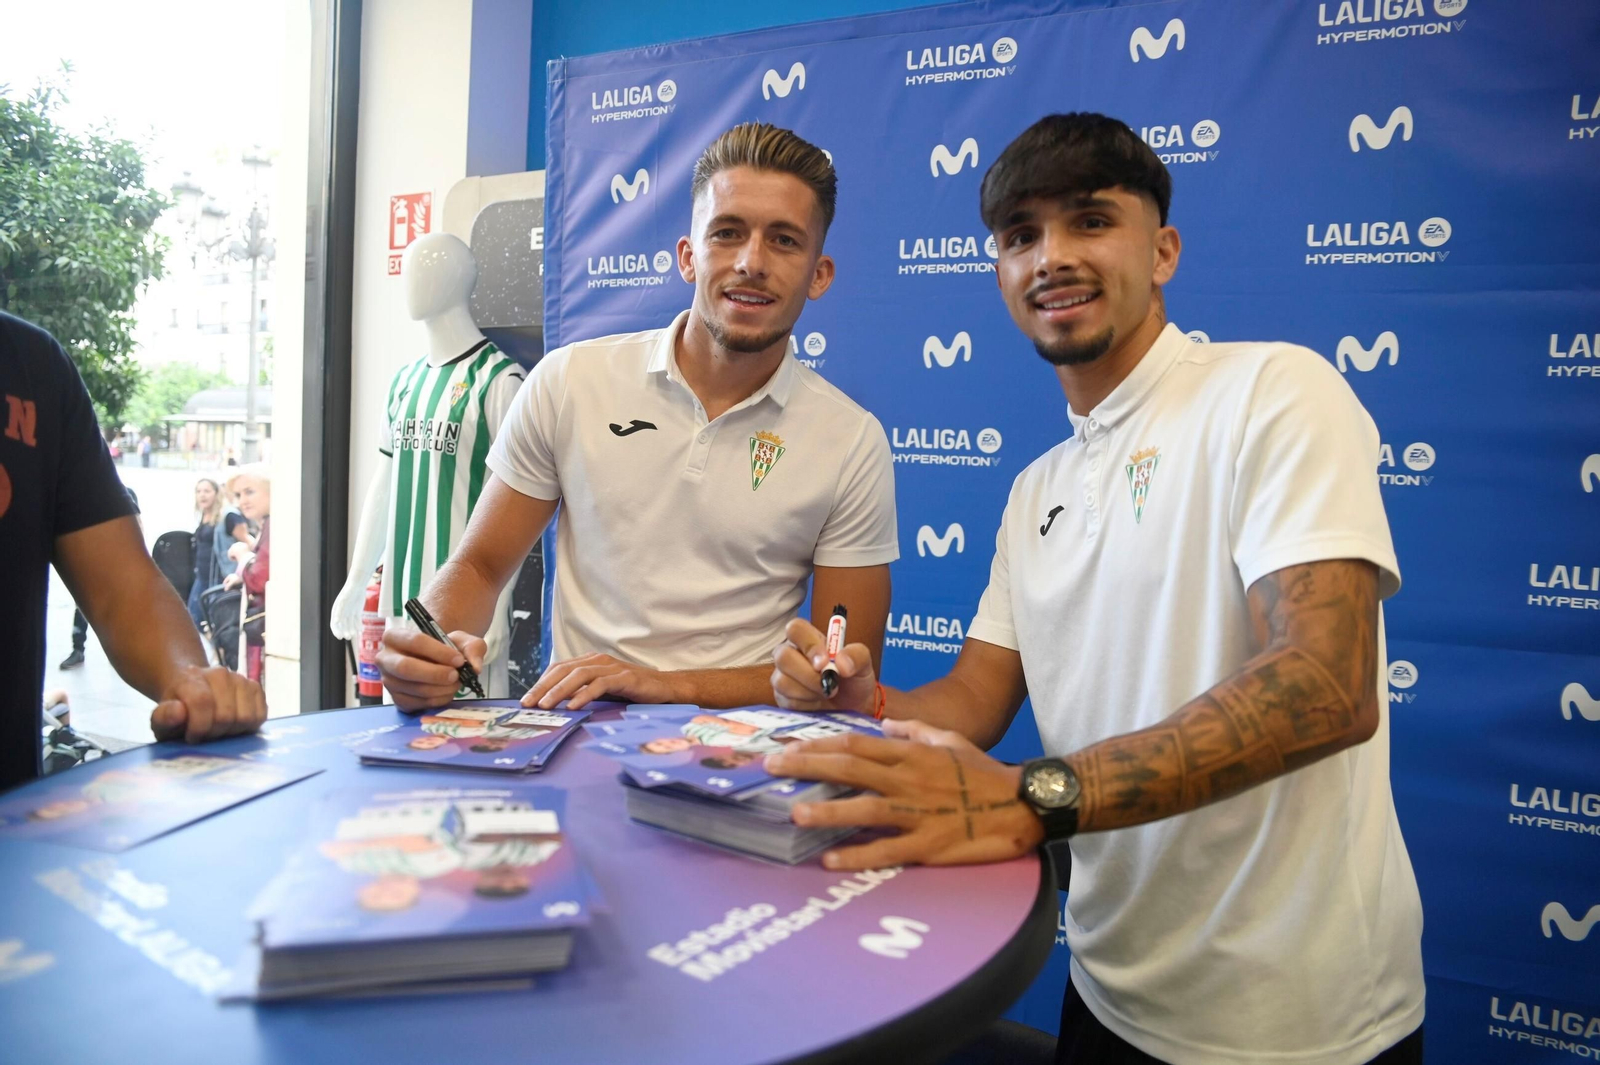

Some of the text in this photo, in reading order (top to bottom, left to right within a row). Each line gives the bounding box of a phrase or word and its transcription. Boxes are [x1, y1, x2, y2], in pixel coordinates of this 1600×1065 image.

[906, 43, 986, 70] LALIGA
[592, 85, 652, 110] LALIGA
[1307, 221, 1410, 247] LALIGA
[899, 236, 979, 259] LALIGA
[587, 254, 649, 275] LALIGA
[892, 427, 971, 450] LALIGA
[886, 612, 964, 640] LALIGA
